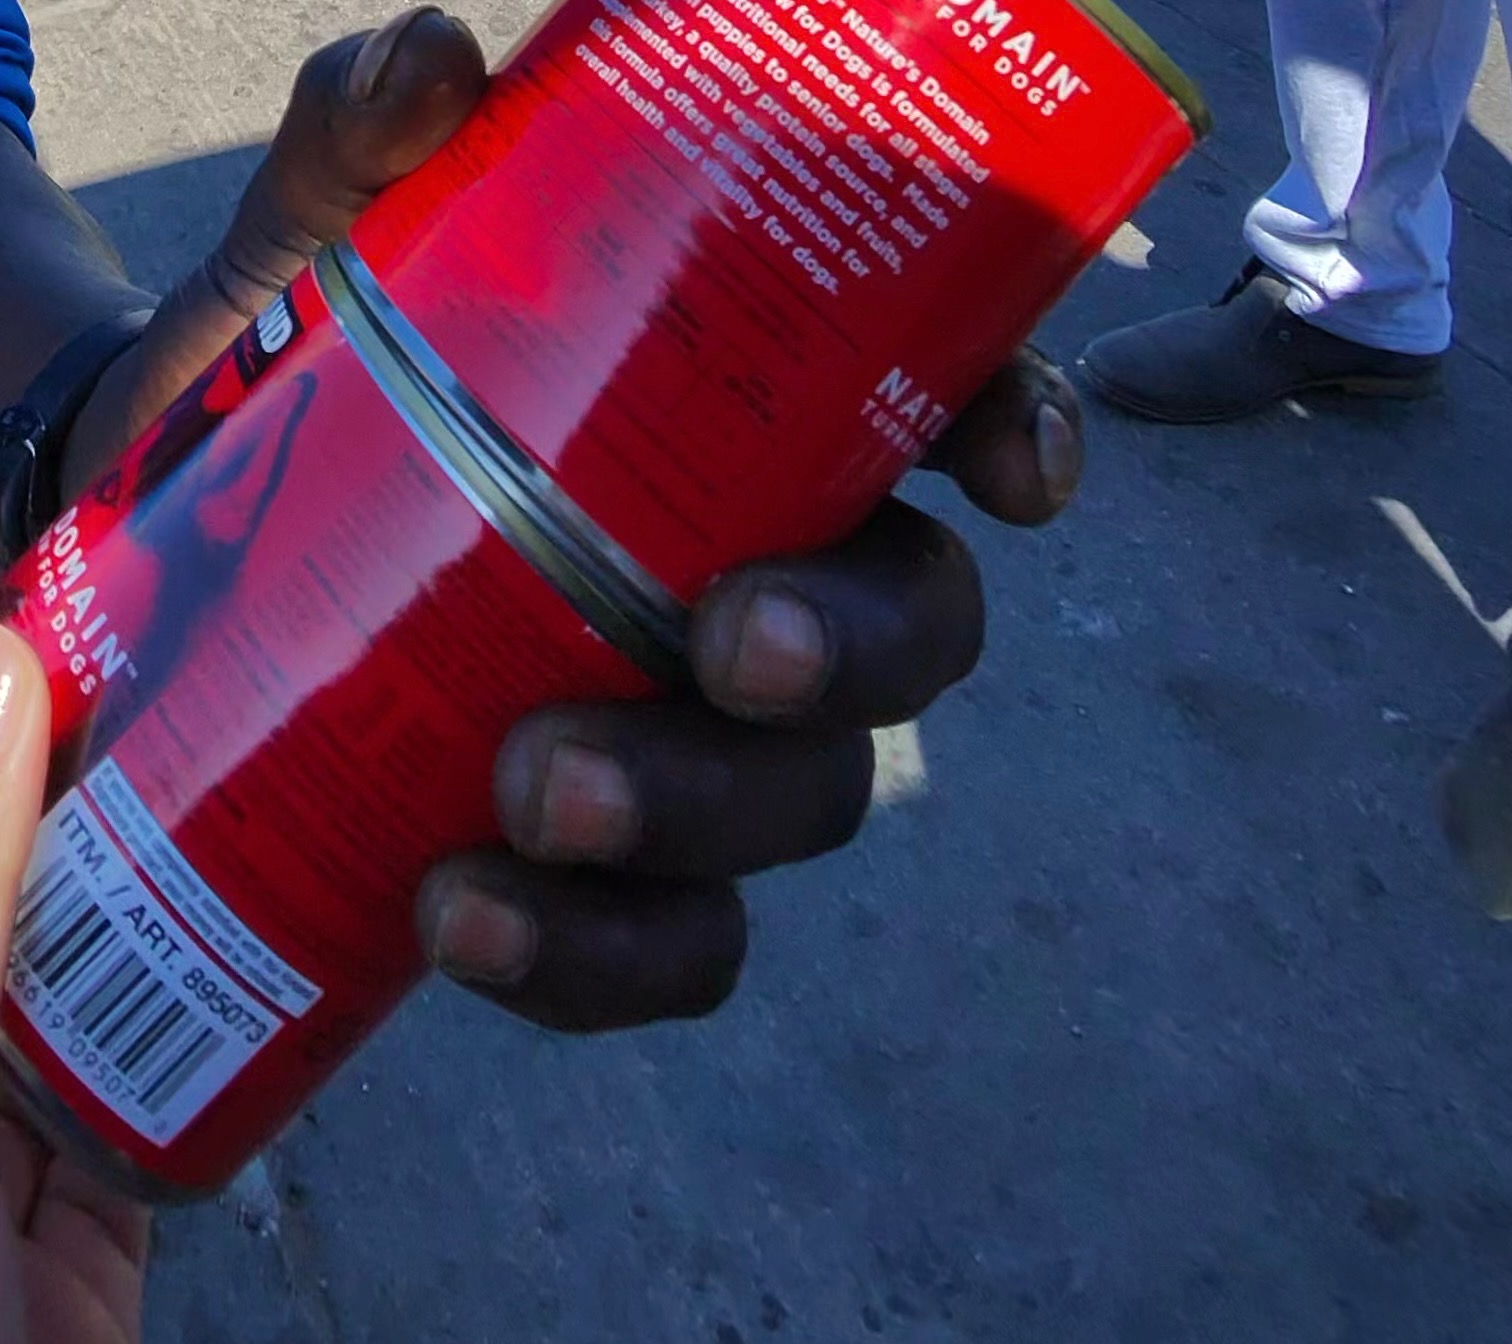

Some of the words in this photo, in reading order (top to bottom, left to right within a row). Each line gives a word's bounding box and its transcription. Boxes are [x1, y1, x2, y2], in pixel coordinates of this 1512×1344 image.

[684, 29, 700, 45] a
[698, 40, 759, 95] quality
[753, 92, 825, 157] protein
[890, 215, 928, 248] and
[696, 2, 766, 63] puppies
[764, 57, 788, 82] to
[786, 79, 847, 133] senior
[792, 4, 824, 34] for
[821, 29, 873, 79] Dogs
[870, 72, 892, 96] is
[889, 89, 990, 183] formulated
[801, 53, 860, 107] needs
[858, 102, 891, 132] for
[887, 131, 919, 157] all
[841, 7, 921, 82] Nature's
[919, 75, 989, 145] Domain
[935, 4, 987, 52] FOR
[993, 55, 1057, 115] DOGS
[575, 44, 621, 86] overall
[615, 77, 665, 129] health
[663, 125, 704, 161] and
[762, 214, 793, 246] for
[609, 35, 664, 89] formula
[663, 86, 714, 134] offers
[762, 177, 841, 253] nutrition
[840, 247, 870, 277] for
[683, 63, 722, 103] with
[722, 98, 820, 192] vegetables
[819, 189, 860, 226] and
[51, 611, 97, 696] DOGS
[56, 807, 110, 883] ITM.
[122, 903, 185, 971] ART.
[179, 965, 266, 1044] 895073
